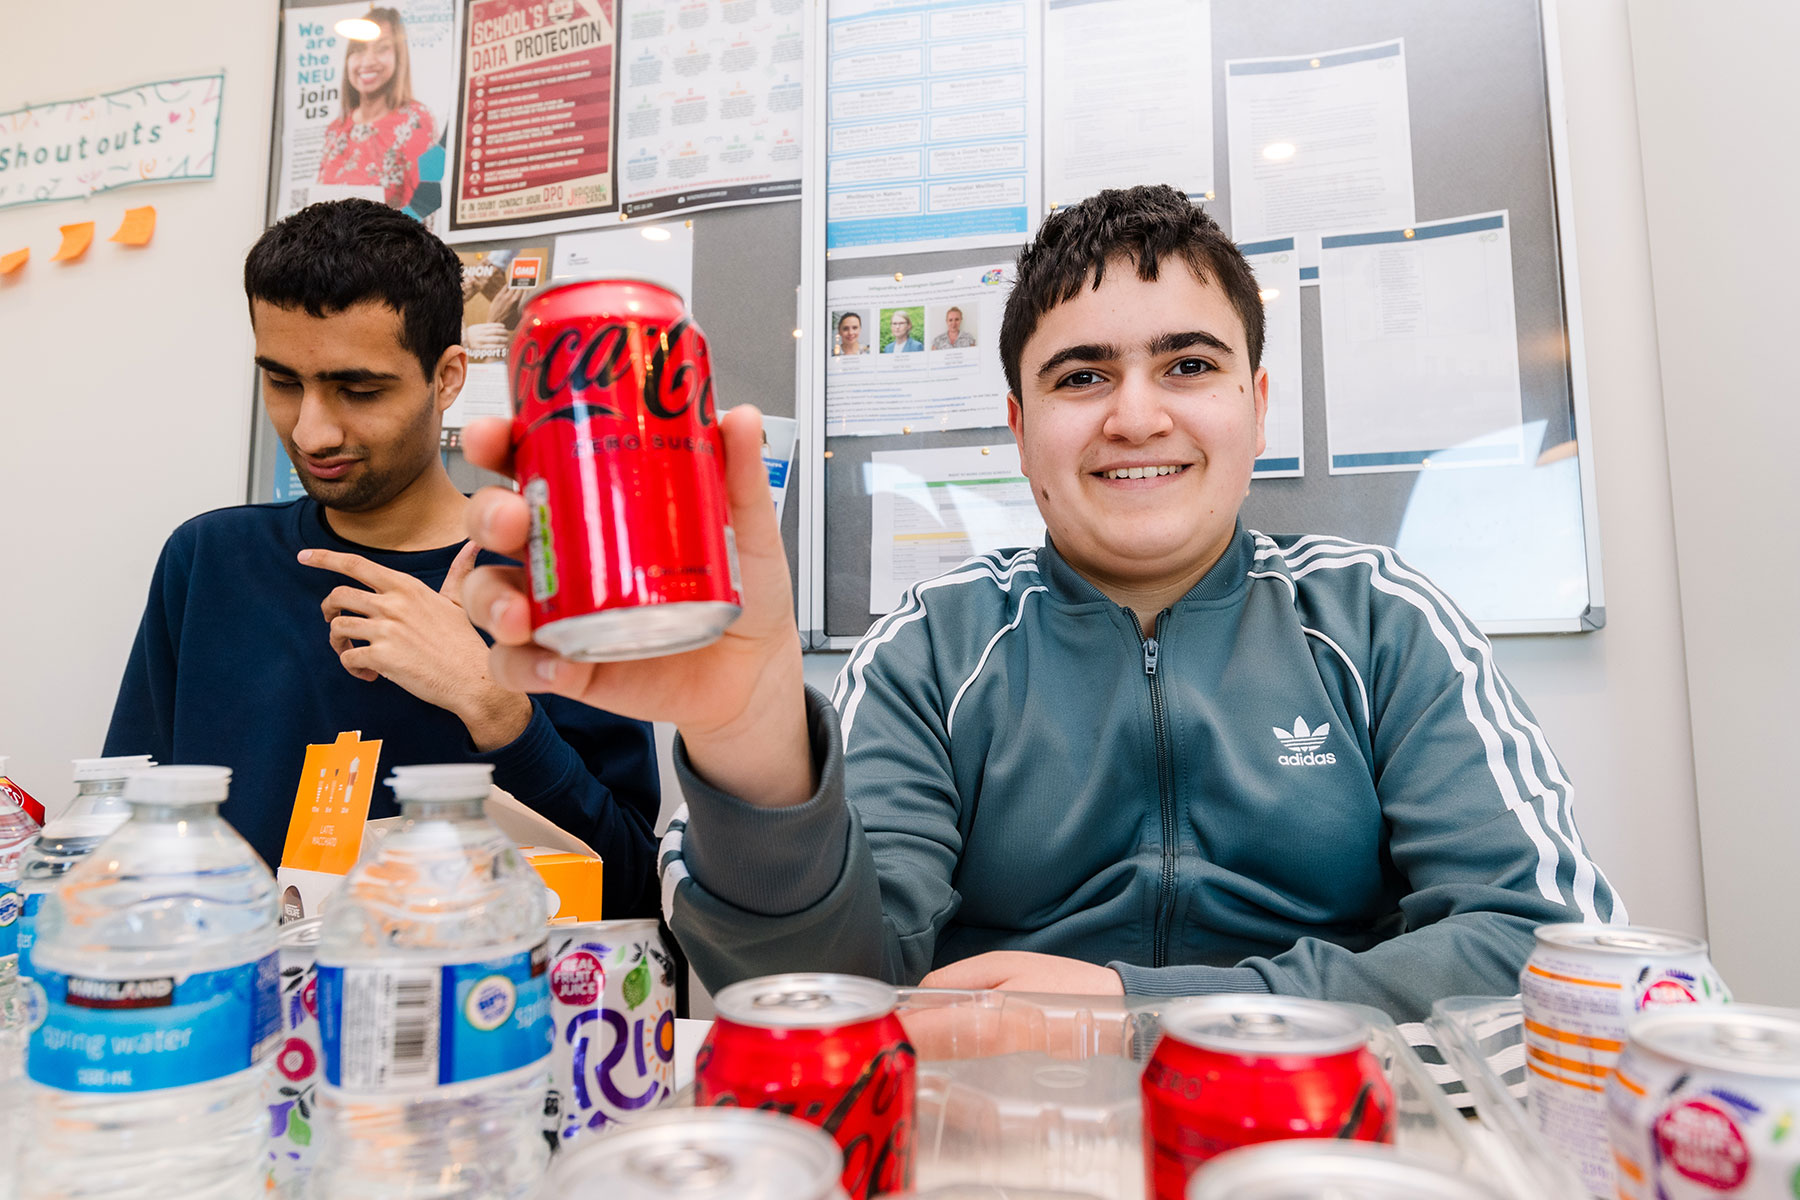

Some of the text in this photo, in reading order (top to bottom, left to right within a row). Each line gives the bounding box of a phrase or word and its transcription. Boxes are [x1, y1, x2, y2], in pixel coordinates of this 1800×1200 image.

[299, 23, 325, 37] We
[474, 5, 544, 45] SCHOOL'S
[305, 36, 337, 50] are
[473, 44, 508, 72] DATA
[515, 20, 602, 62] PROTECTION
[298, 52, 330, 67] the
[298, 67, 335, 85] NEU
[297, 85, 338, 109] join
[305, 105, 328, 119] us
[543, 185, 564, 202] DPO
[462, 265, 536, 278] NION GMB
[1278, 751, 1337, 766] adidas
[560, 958, 596, 971] REAL
[553, 970, 591, 985] FRUIT
[559, 982, 596, 997] JUICE
[110, 1026, 192, 1056] water
